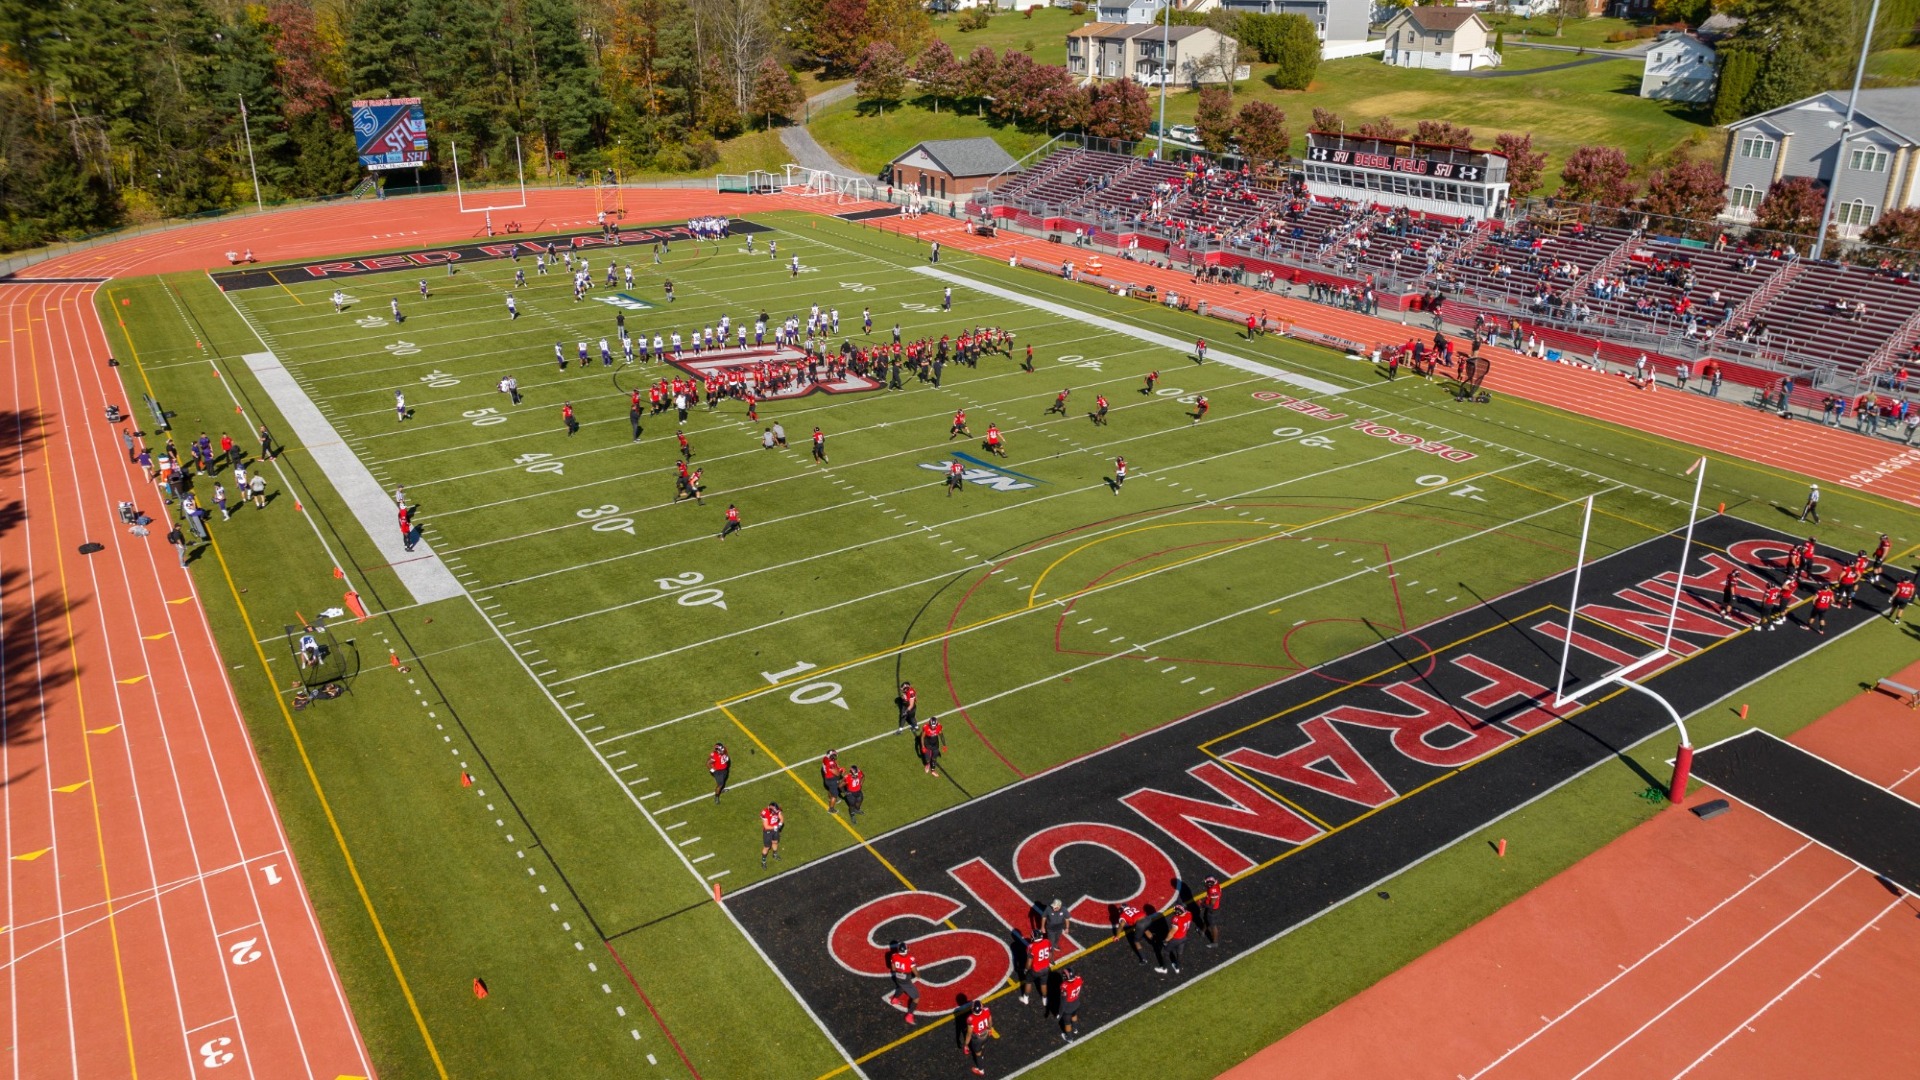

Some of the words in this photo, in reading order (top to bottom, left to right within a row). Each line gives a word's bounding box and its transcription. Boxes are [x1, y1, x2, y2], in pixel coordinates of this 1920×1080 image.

[1333, 151, 1349, 163] SFU
[1354, 152, 1391, 169] DEGOL
[1394, 157, 1427, 174] FIELD
[1434, 163, 1453, 176] SFU
[304, 251, 461, 277] RED
[479, 227, 693, 255] FLASH
[1057, 354, 1103, 370] 40
[420, 373, 461, 387] 40
[462, 407, 507, 426] 50
[1251, 391, 1349, 421] FIELD
[1272, 427, 1333, 448] 20
[1350, 418, 1478, 463] DEGOL
[514, 453, 564, 474] 40
[1415, 475, 1485, 498] 10
[577, 504, 634, 533] 30
[655, 571, 725, 607] 20
[1531, 539, 1848, 683] SAINT
[761, 660, 843, 705] 10
[828, 653, 1587, 1016] FRANCIS
[260, 863, 283, 886] 1
[230, 937, 262, 965] 2
[1038, 947, 1050, 962] 95
[200, 1037, 234, 1068] 3
